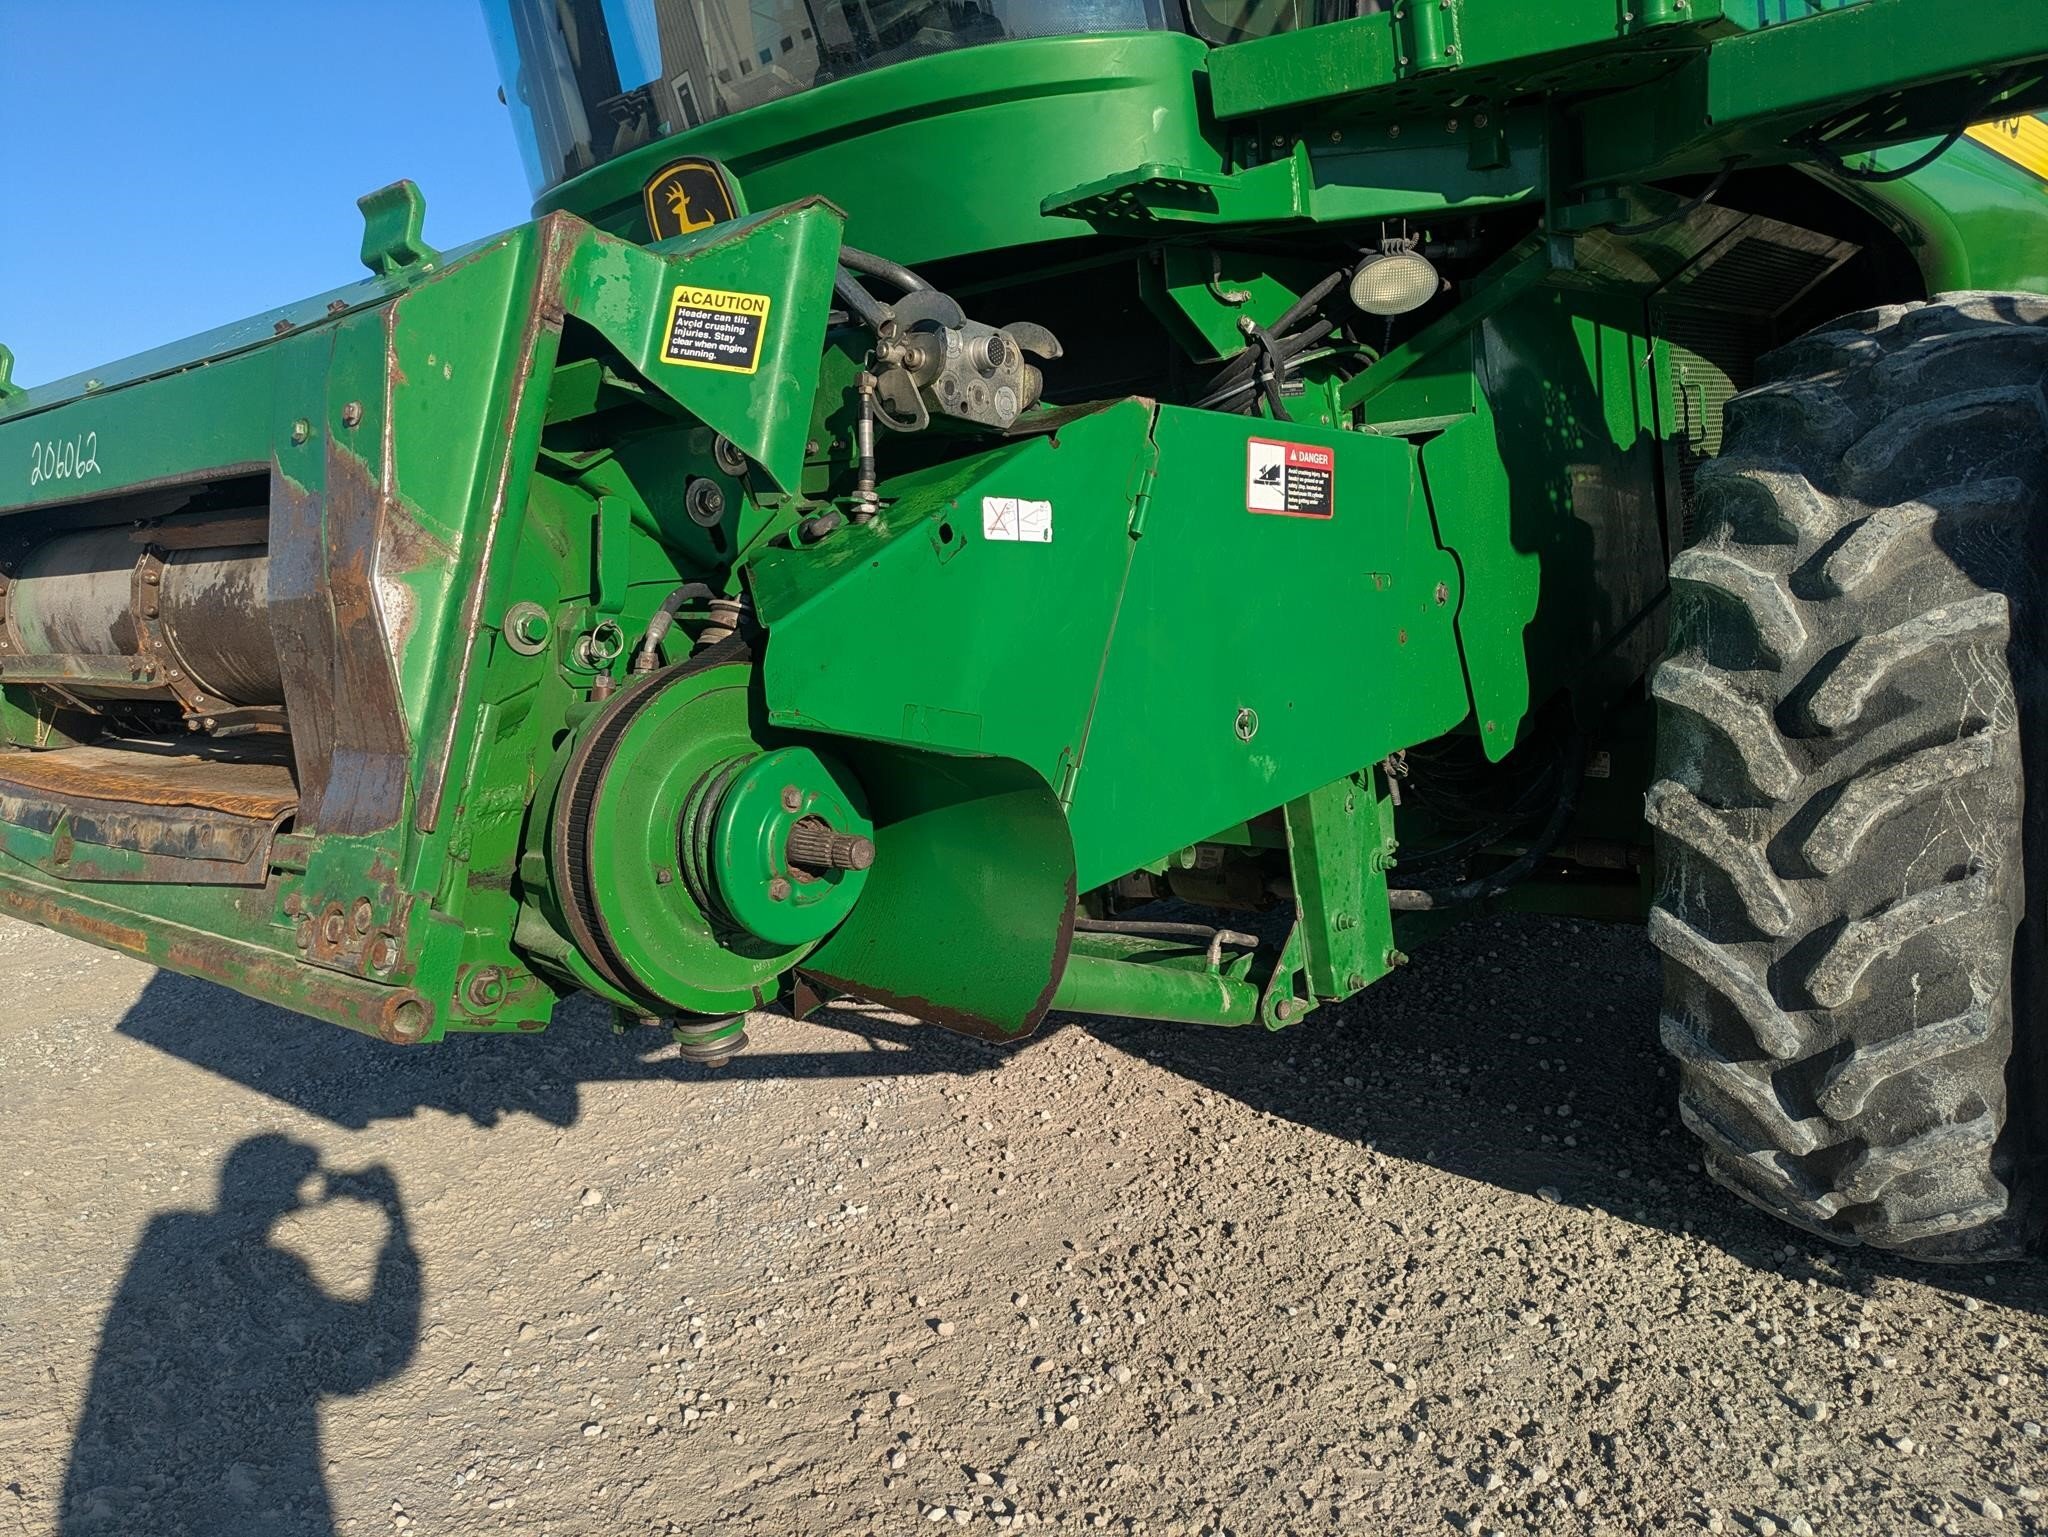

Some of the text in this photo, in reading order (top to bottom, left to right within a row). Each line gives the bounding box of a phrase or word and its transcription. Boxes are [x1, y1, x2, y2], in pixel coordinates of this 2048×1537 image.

[692, 292, 764, 312] CAUTION
[679, 308, 749, 324] Header can tilt.
[676, 318, 745, 335] Avoid crushing
[672, 337, 747, 353] clear when engine
[714, 332, 735, 343] Stay
[671, 346, 716, 360] is running.
[31, 431, 101, 486] 206062
[1299, 452, 1328, 464] DANGER
